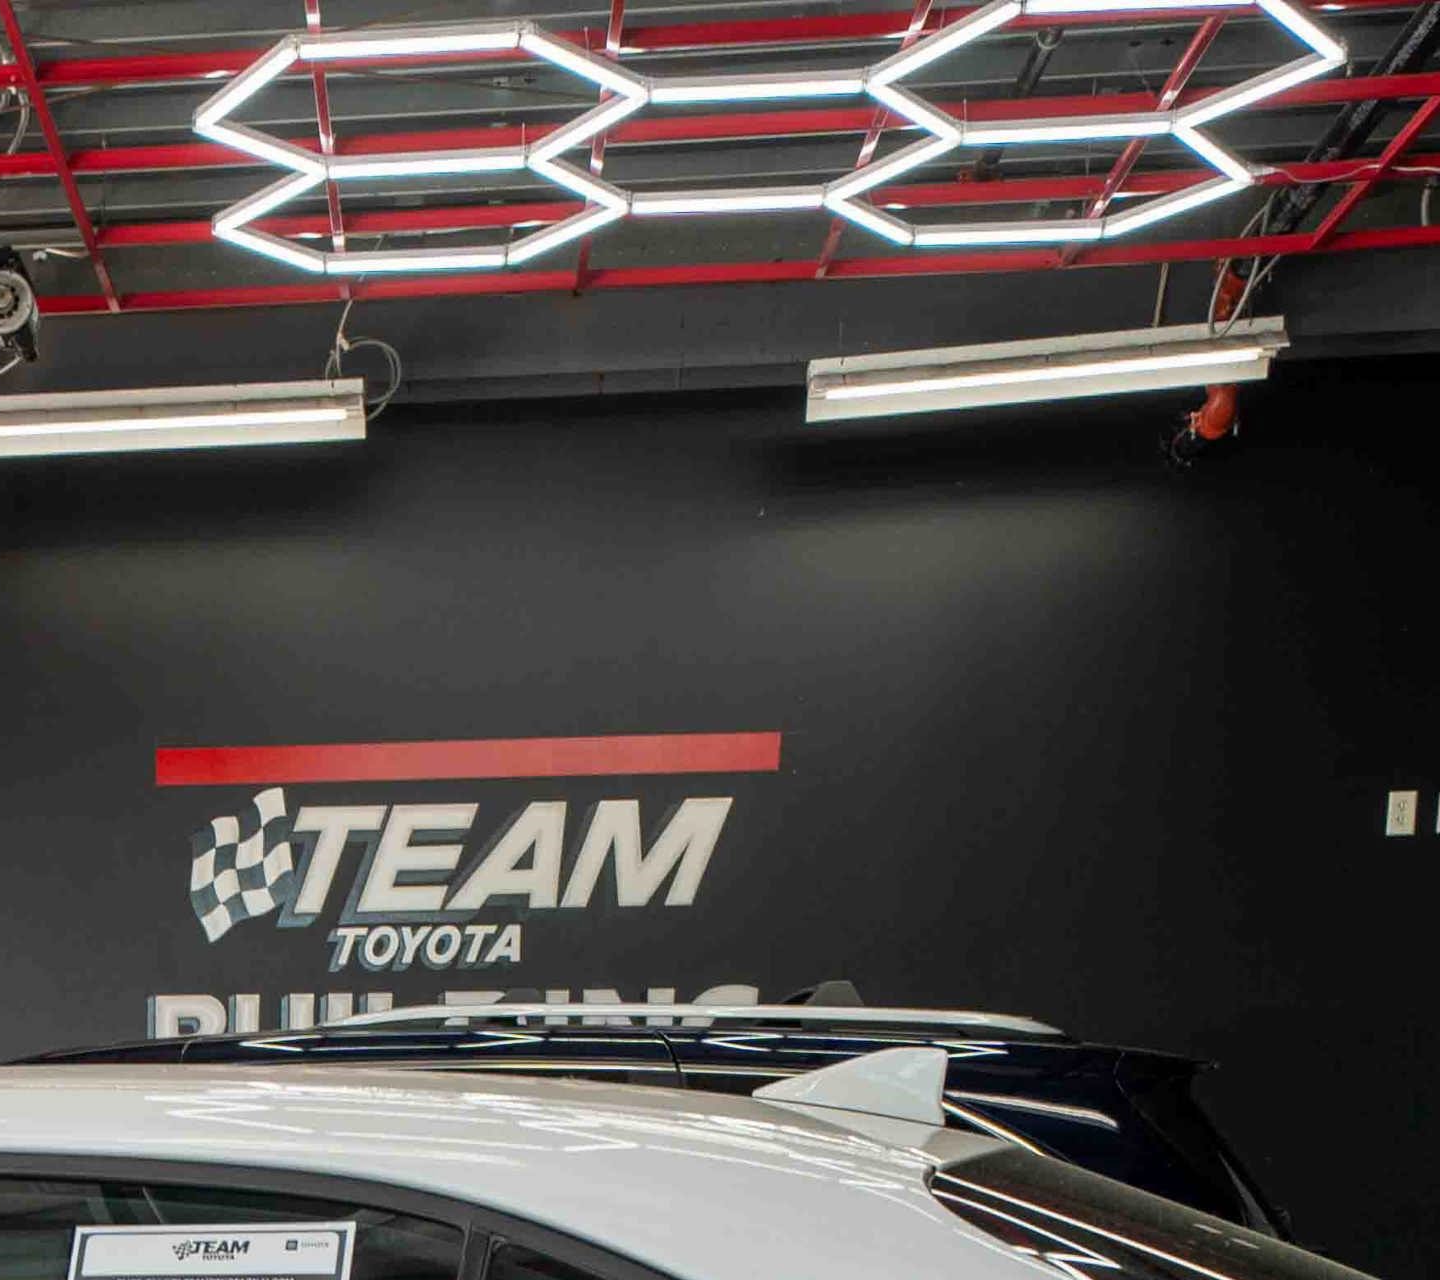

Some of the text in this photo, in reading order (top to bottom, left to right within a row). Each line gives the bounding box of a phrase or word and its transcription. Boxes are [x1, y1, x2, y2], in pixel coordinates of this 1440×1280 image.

[286, 797, 733, 920] TEAM
[332, 924, 522, 967] TOYOTA
[192, 1240, 251, 1254] TEAM
